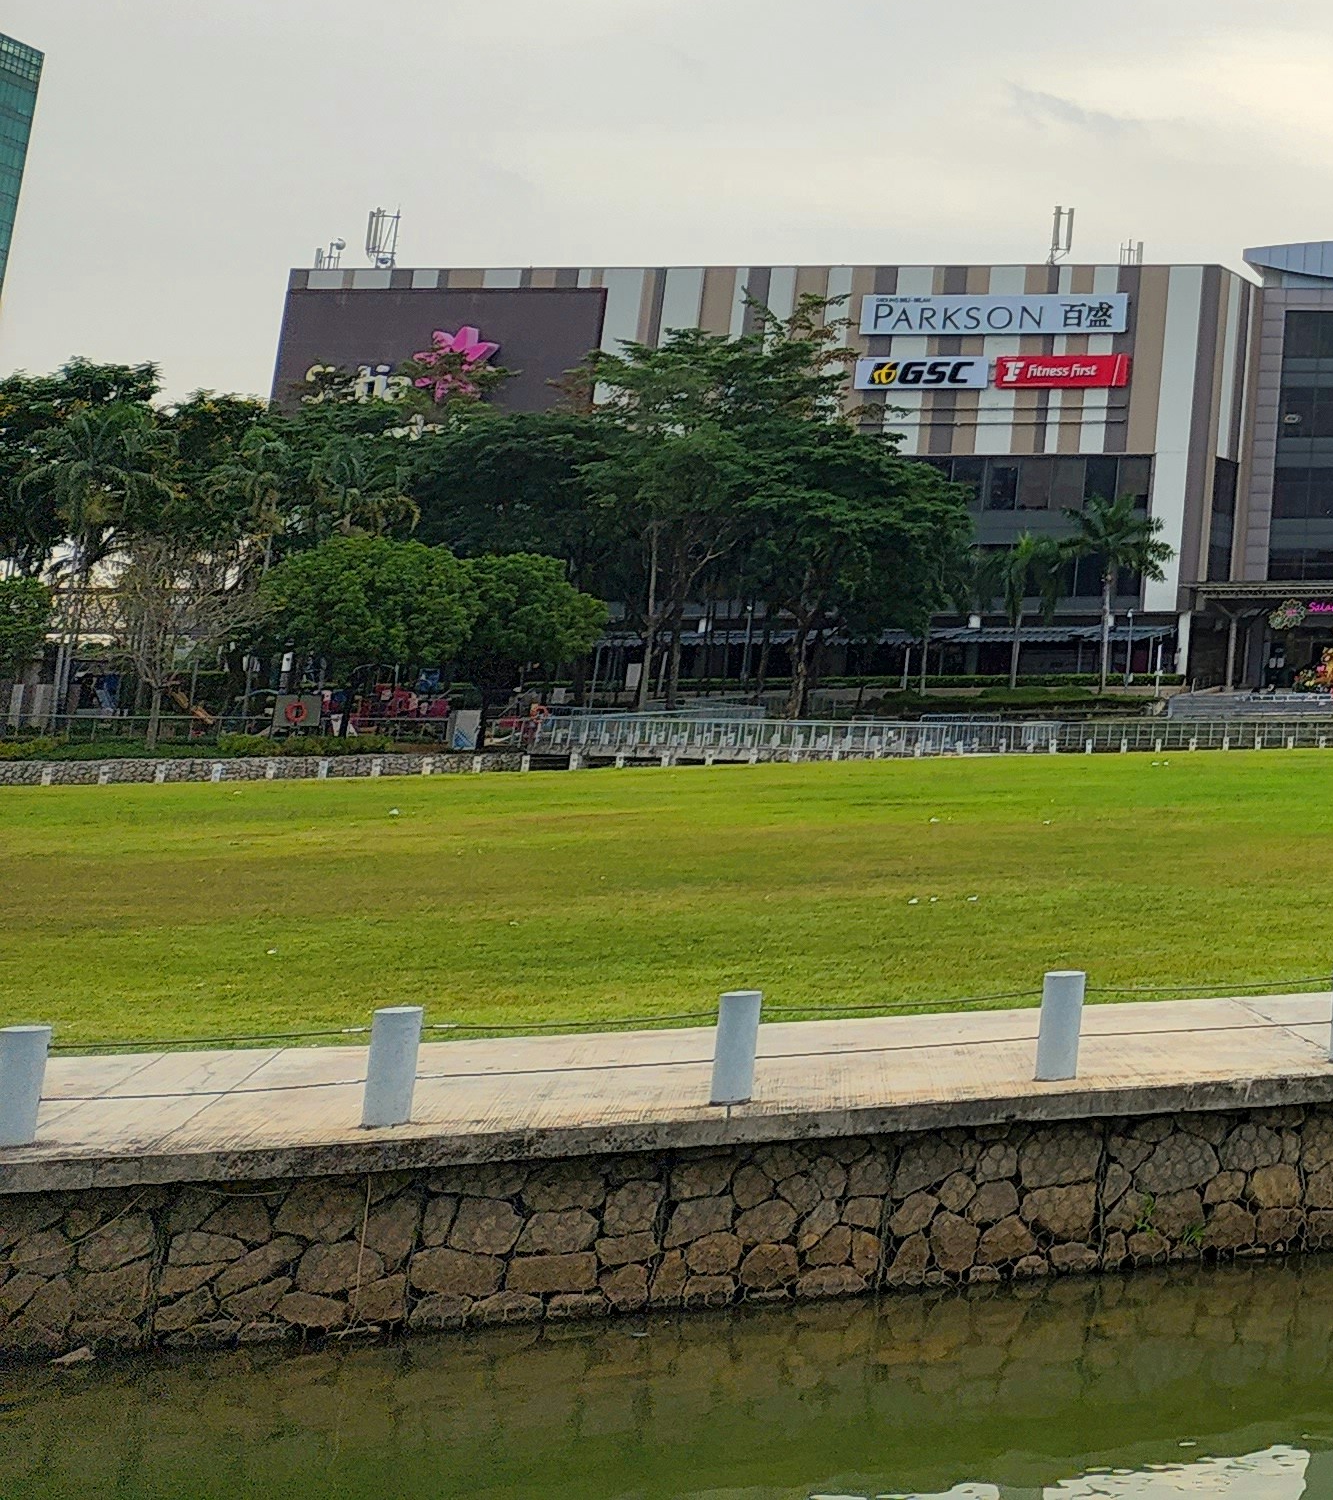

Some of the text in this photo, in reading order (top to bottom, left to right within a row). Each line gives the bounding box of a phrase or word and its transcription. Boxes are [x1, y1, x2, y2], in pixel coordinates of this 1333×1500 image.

[873, 303, 1044, 330] PARKSON
[1060, 301, 1114, 328] 百盛
[898, 361, 975, 384] GSC
[1027, 362, 1097, 378] fitness first
